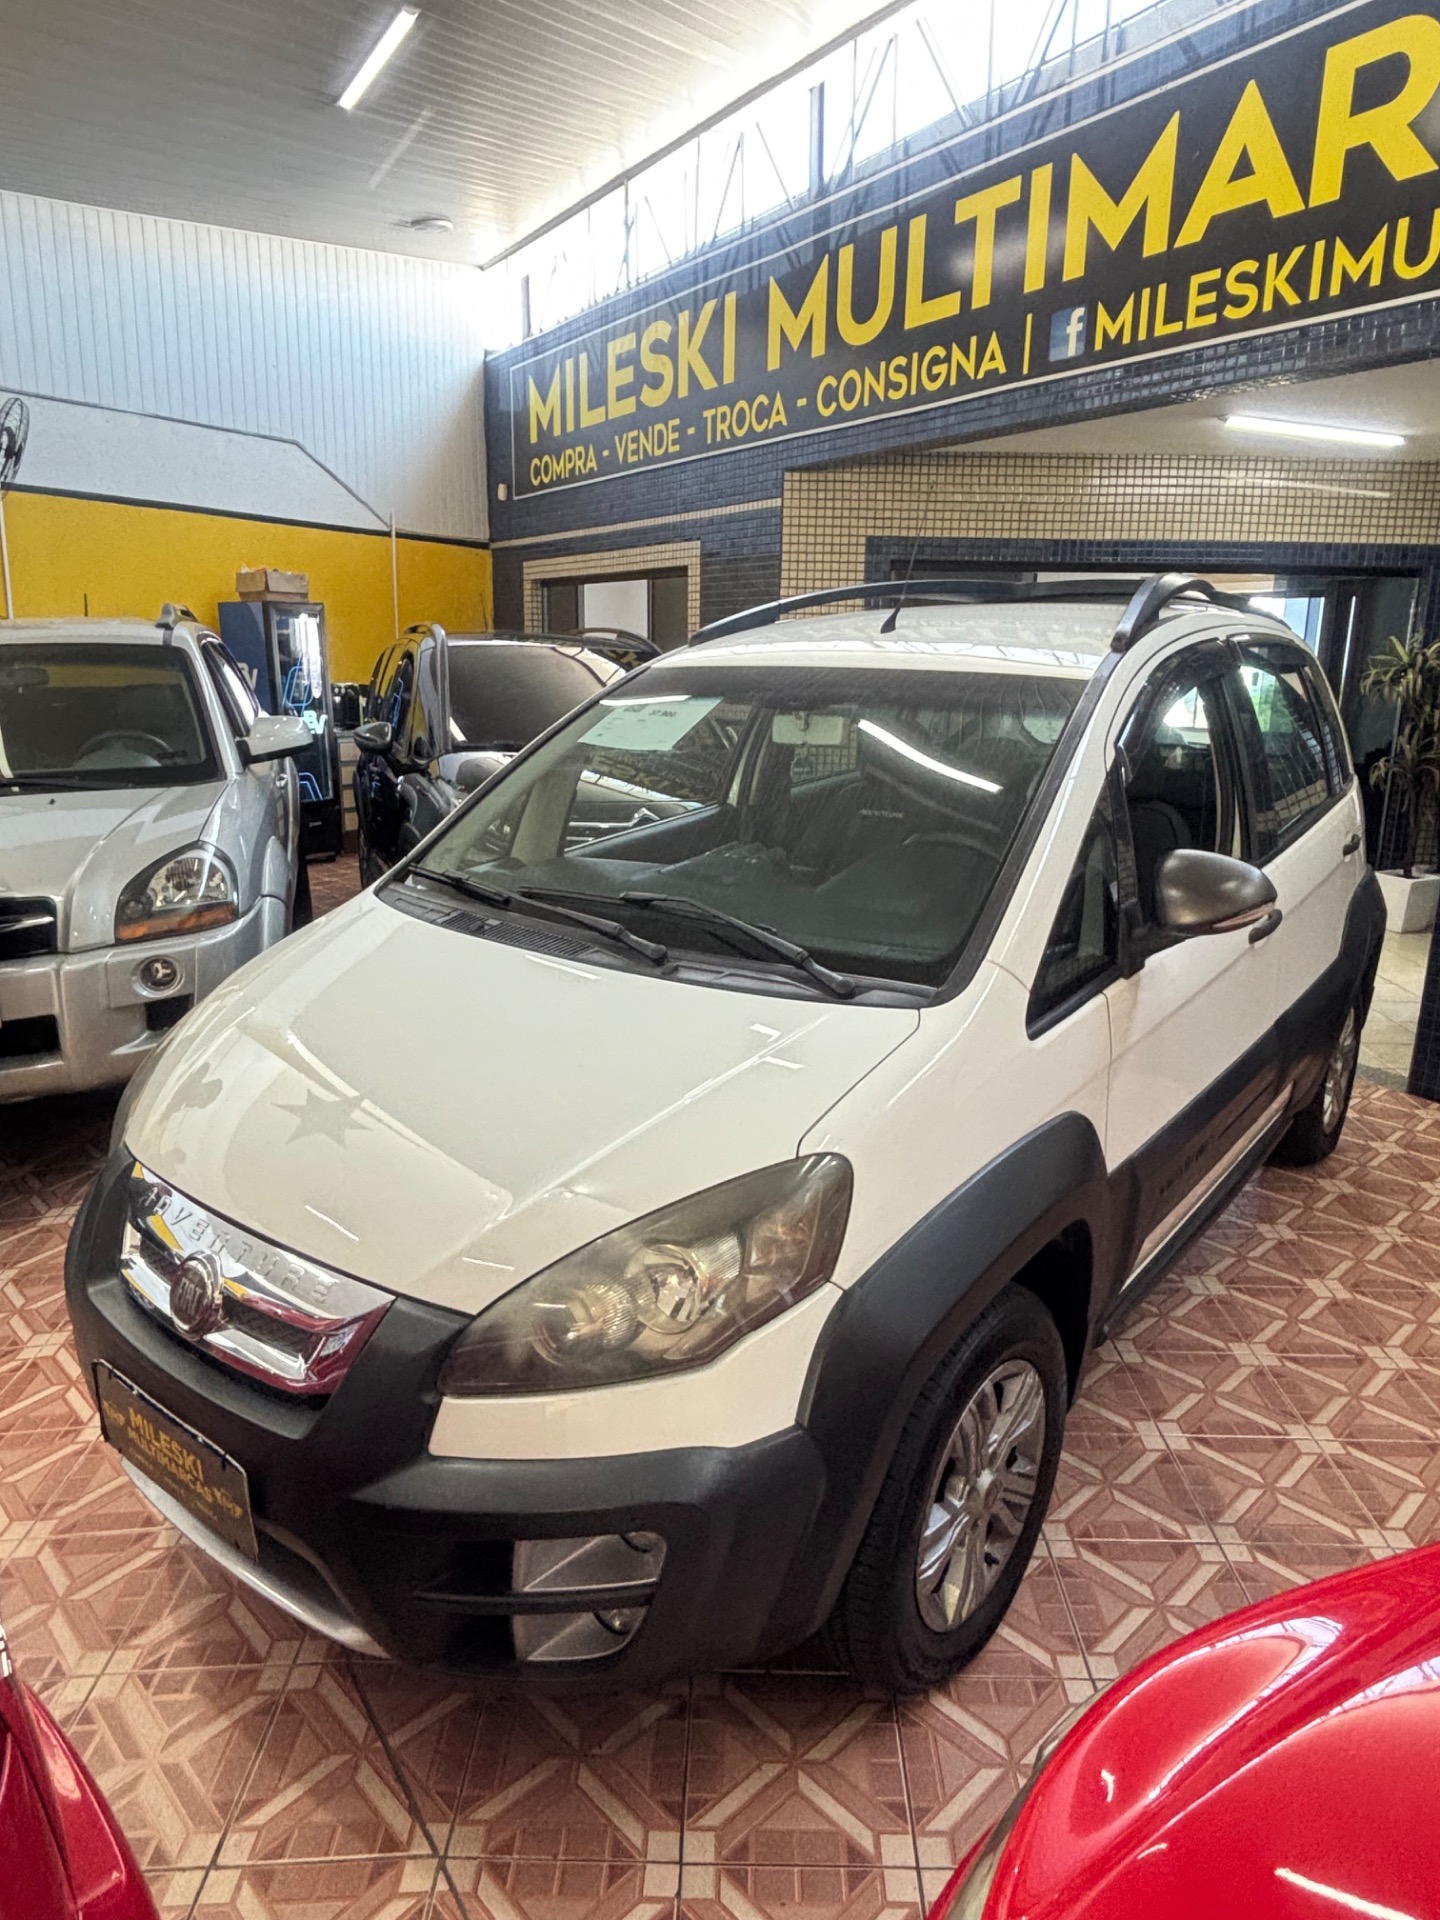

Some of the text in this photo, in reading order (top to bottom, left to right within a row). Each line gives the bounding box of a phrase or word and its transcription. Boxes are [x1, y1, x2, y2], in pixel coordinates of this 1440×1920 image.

[529, 13, 1440, 444] MILESKI MULTIMAR
[1093, 207, 1440, 352] MILESKIMU
[529, 443, 598, 487] COMPRA
[614, 417, 680, 464] VENDE
[703, 390, 788, 444] TROCA
[816, 331, 1007, 417] CONSIGNA
[176, 1277, 204, 1317] FIAT
[127, 1406, 205, 1487] MILESKI
